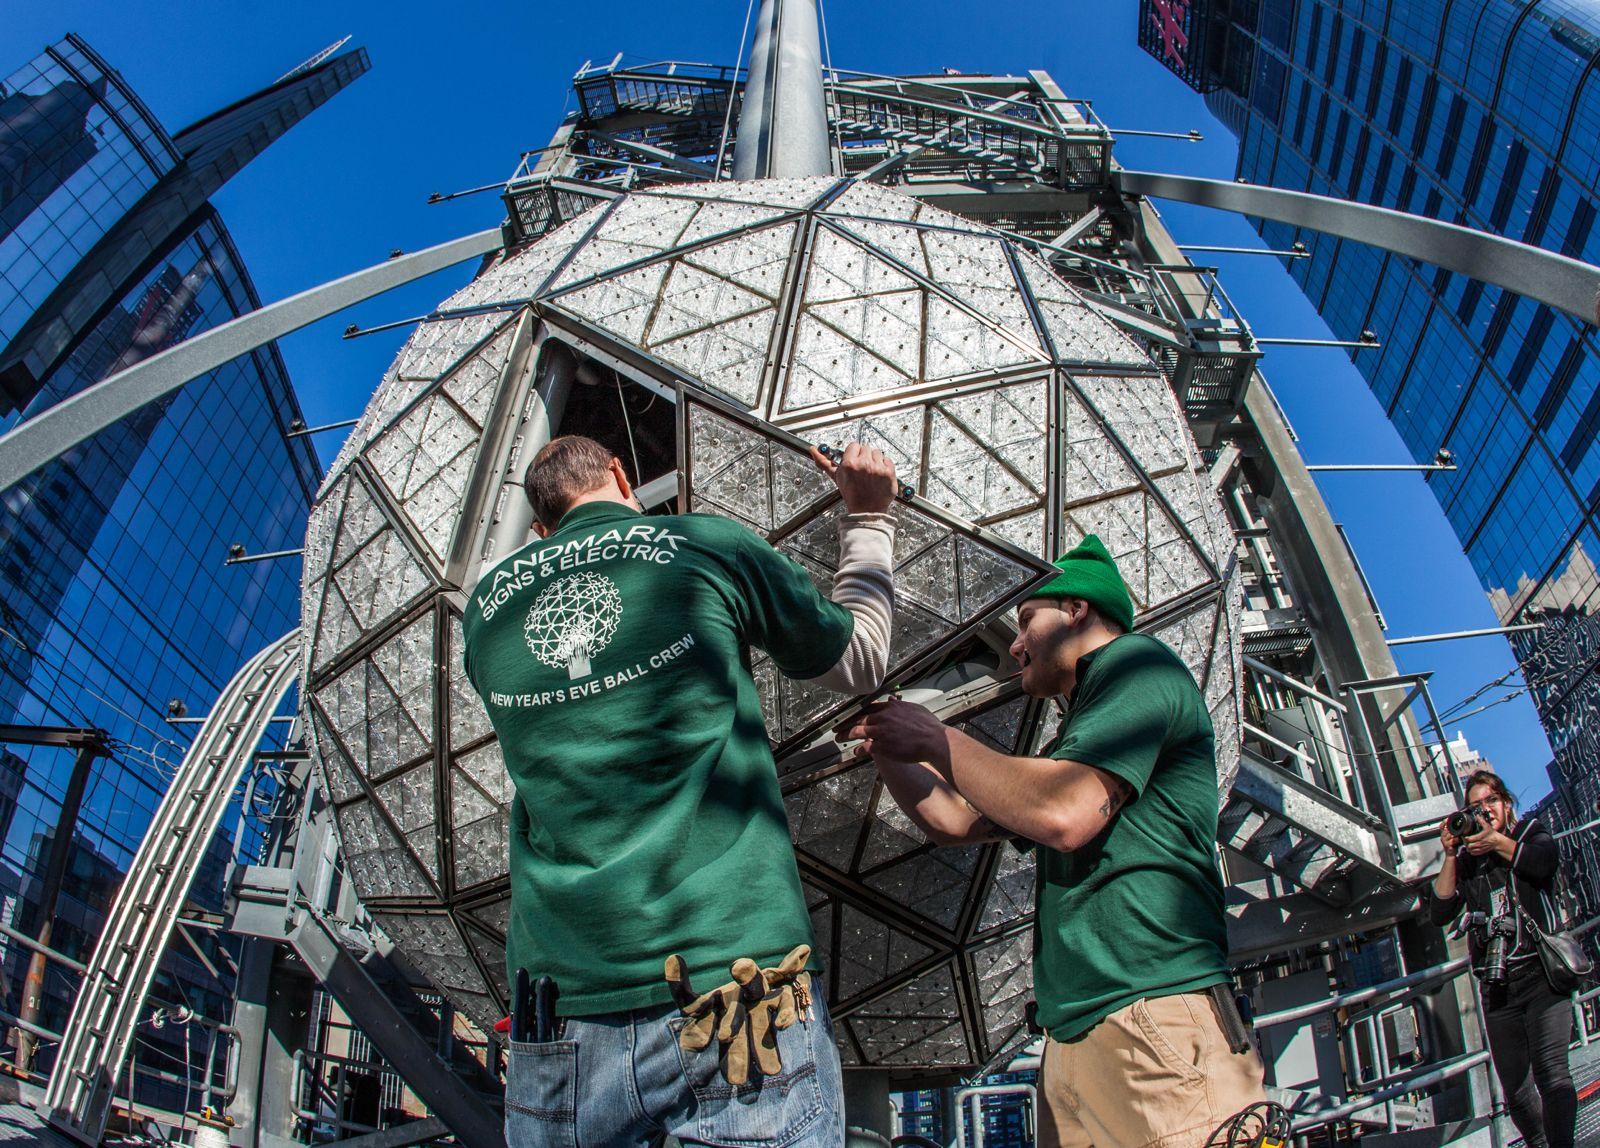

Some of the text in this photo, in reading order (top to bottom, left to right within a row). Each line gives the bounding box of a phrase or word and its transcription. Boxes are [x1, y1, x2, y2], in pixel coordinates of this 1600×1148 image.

[477, 525, 687, 608] LANDMARK
[482, 544, 674, 621] SIGNS & ELECTRIC
[491, 634, 694, 707] NEW YEAR'S EVE BALL CREW
